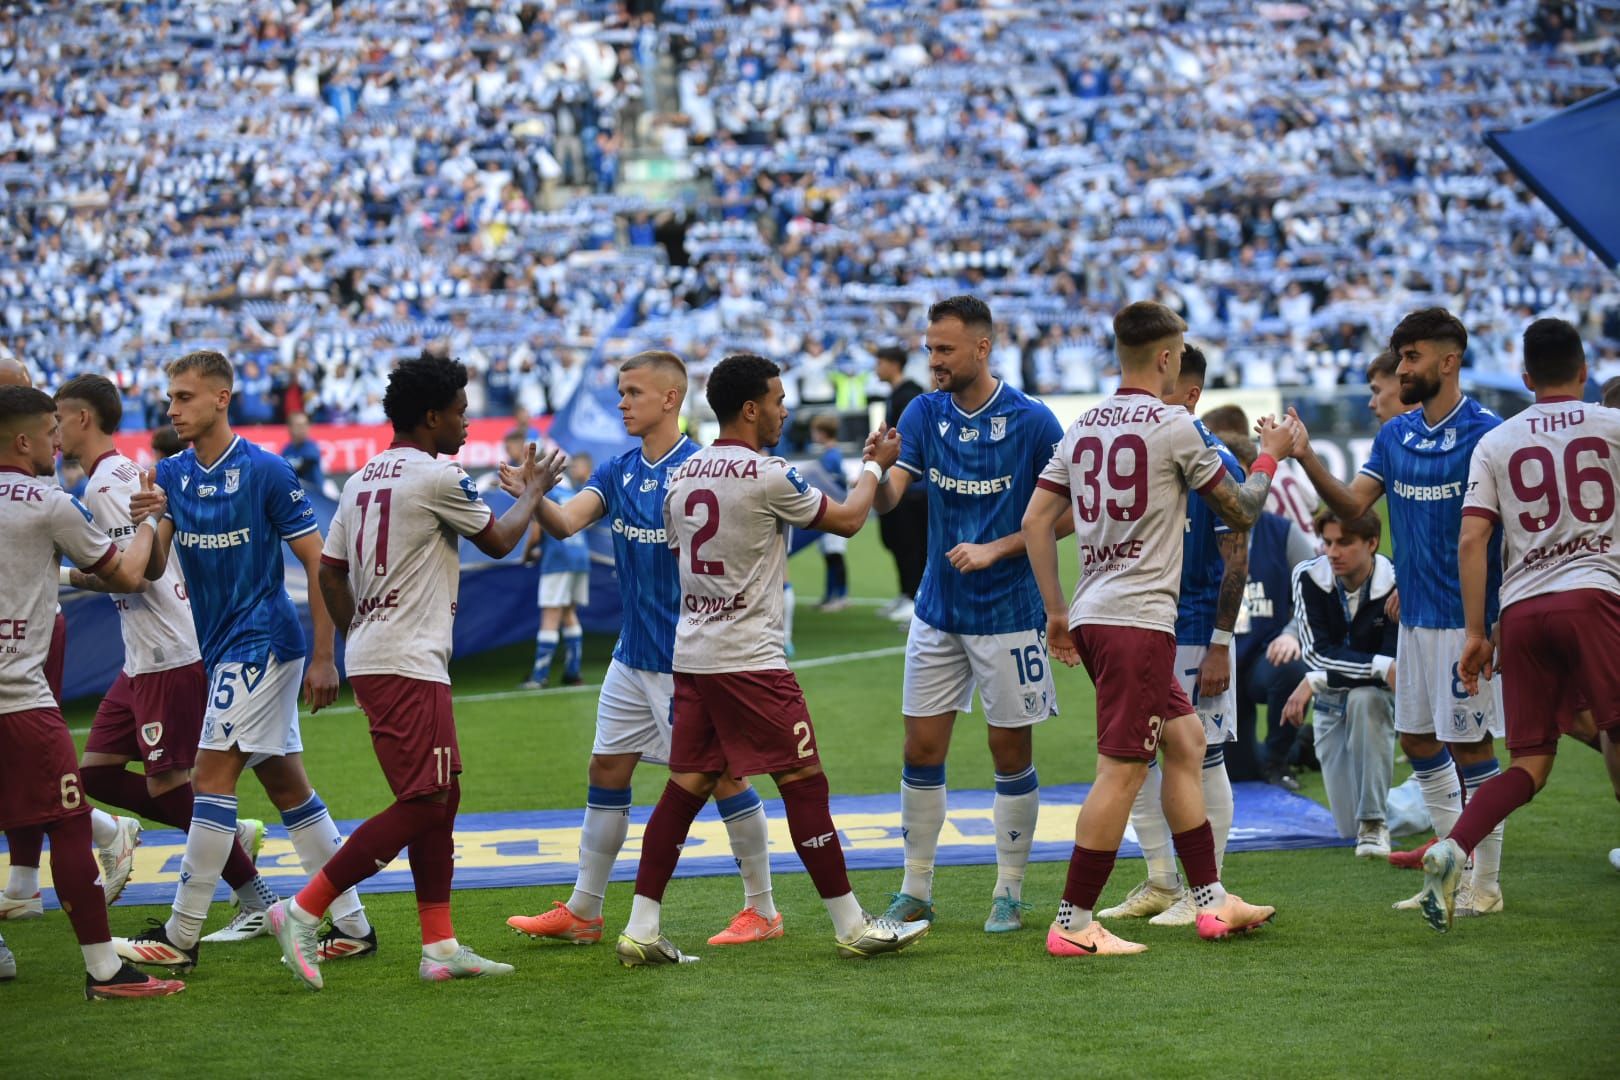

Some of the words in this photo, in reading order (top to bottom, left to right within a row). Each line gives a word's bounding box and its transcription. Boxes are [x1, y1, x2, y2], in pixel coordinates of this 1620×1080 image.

[1526, 409, 1585, 434] TIHO
[362, 459, 407, 481] GALE
[671, 458, 758, 482] EDADKA
[929, 467, 1013, 495] SUPERBET
[1071, 434, 1149, 522] 39
[1507, 437, 1616, 533] 96
[1393, 480, 1462, 501] SUPERBET
[176, 528, 250, 549] UPERBET
[356, 487, 393, 576] 11
[684, 489, 725, 576] 2
[1010, 645, 1044, 685] 16
[793, 720, 815, 758] 2
[433, 747, 453, 786] 11
[61, 774, 81, 810] 6
